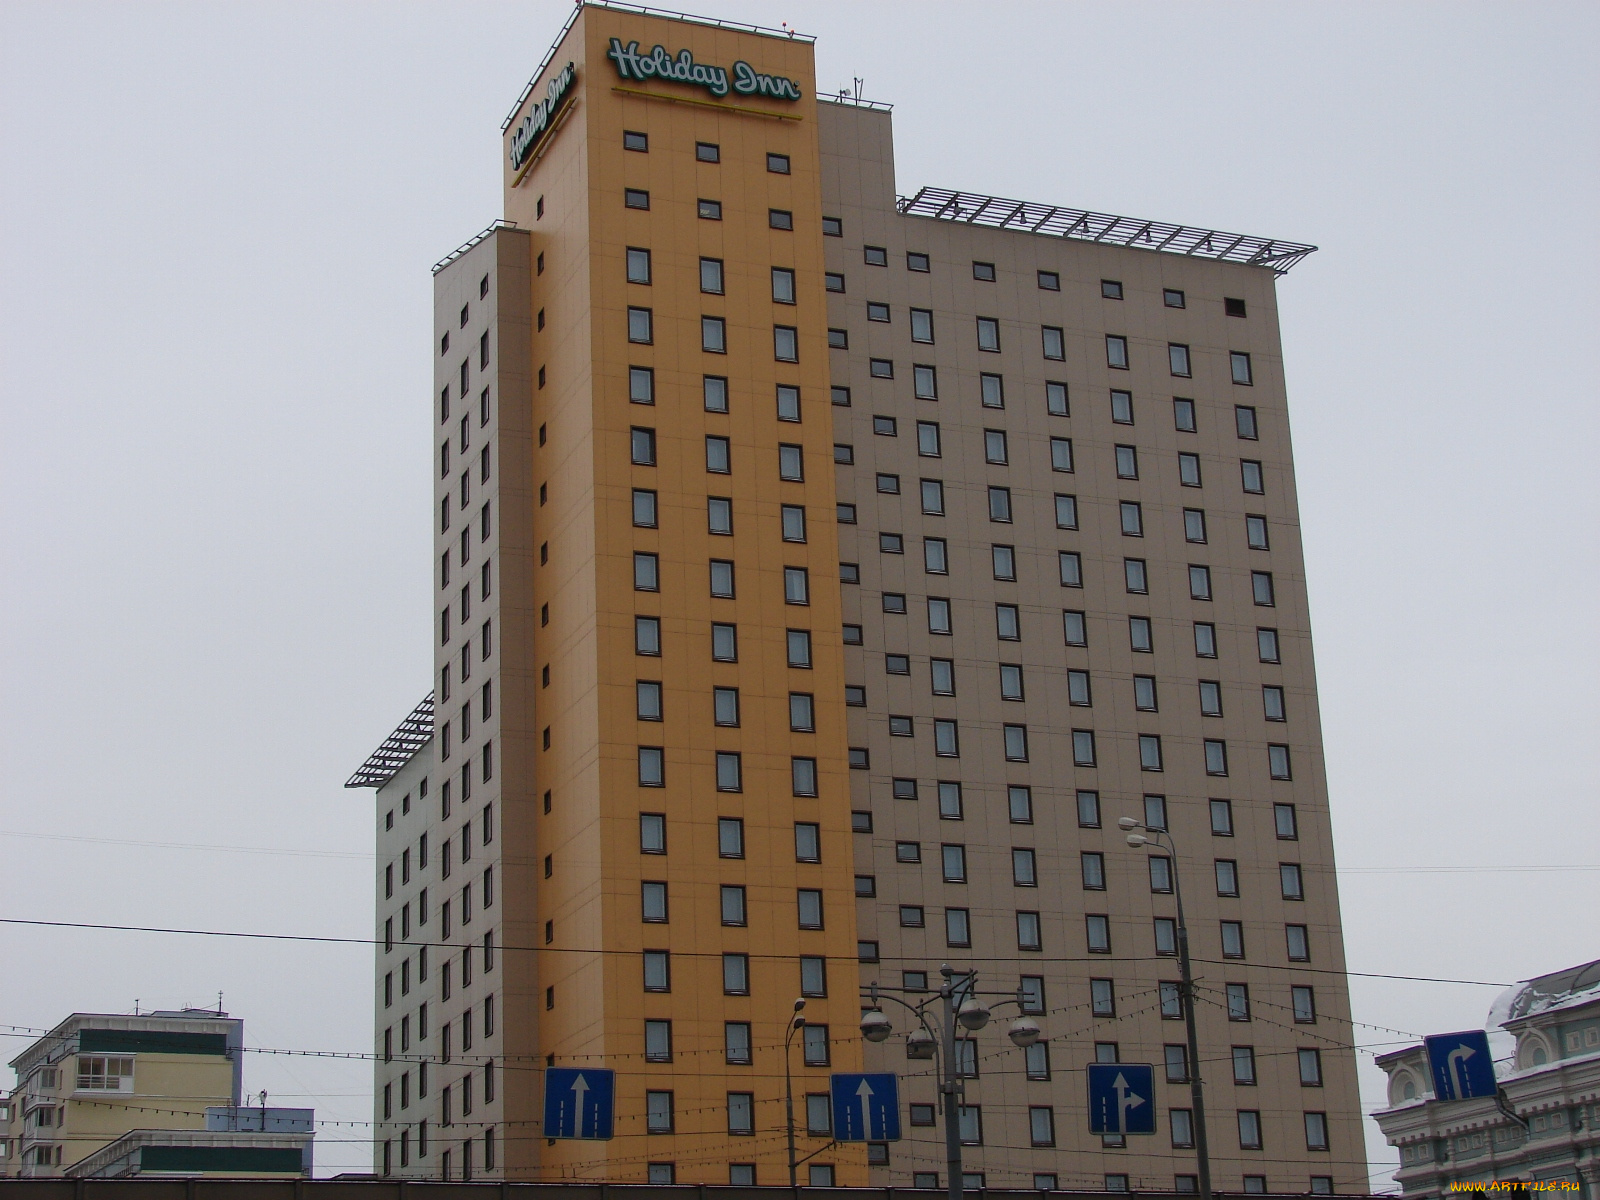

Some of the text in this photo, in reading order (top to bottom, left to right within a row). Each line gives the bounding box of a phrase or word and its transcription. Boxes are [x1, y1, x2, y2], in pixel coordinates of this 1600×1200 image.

[608, 37, 801, 100] Holiday Inn
[510, 65, 574, 171] Holiday Inn
